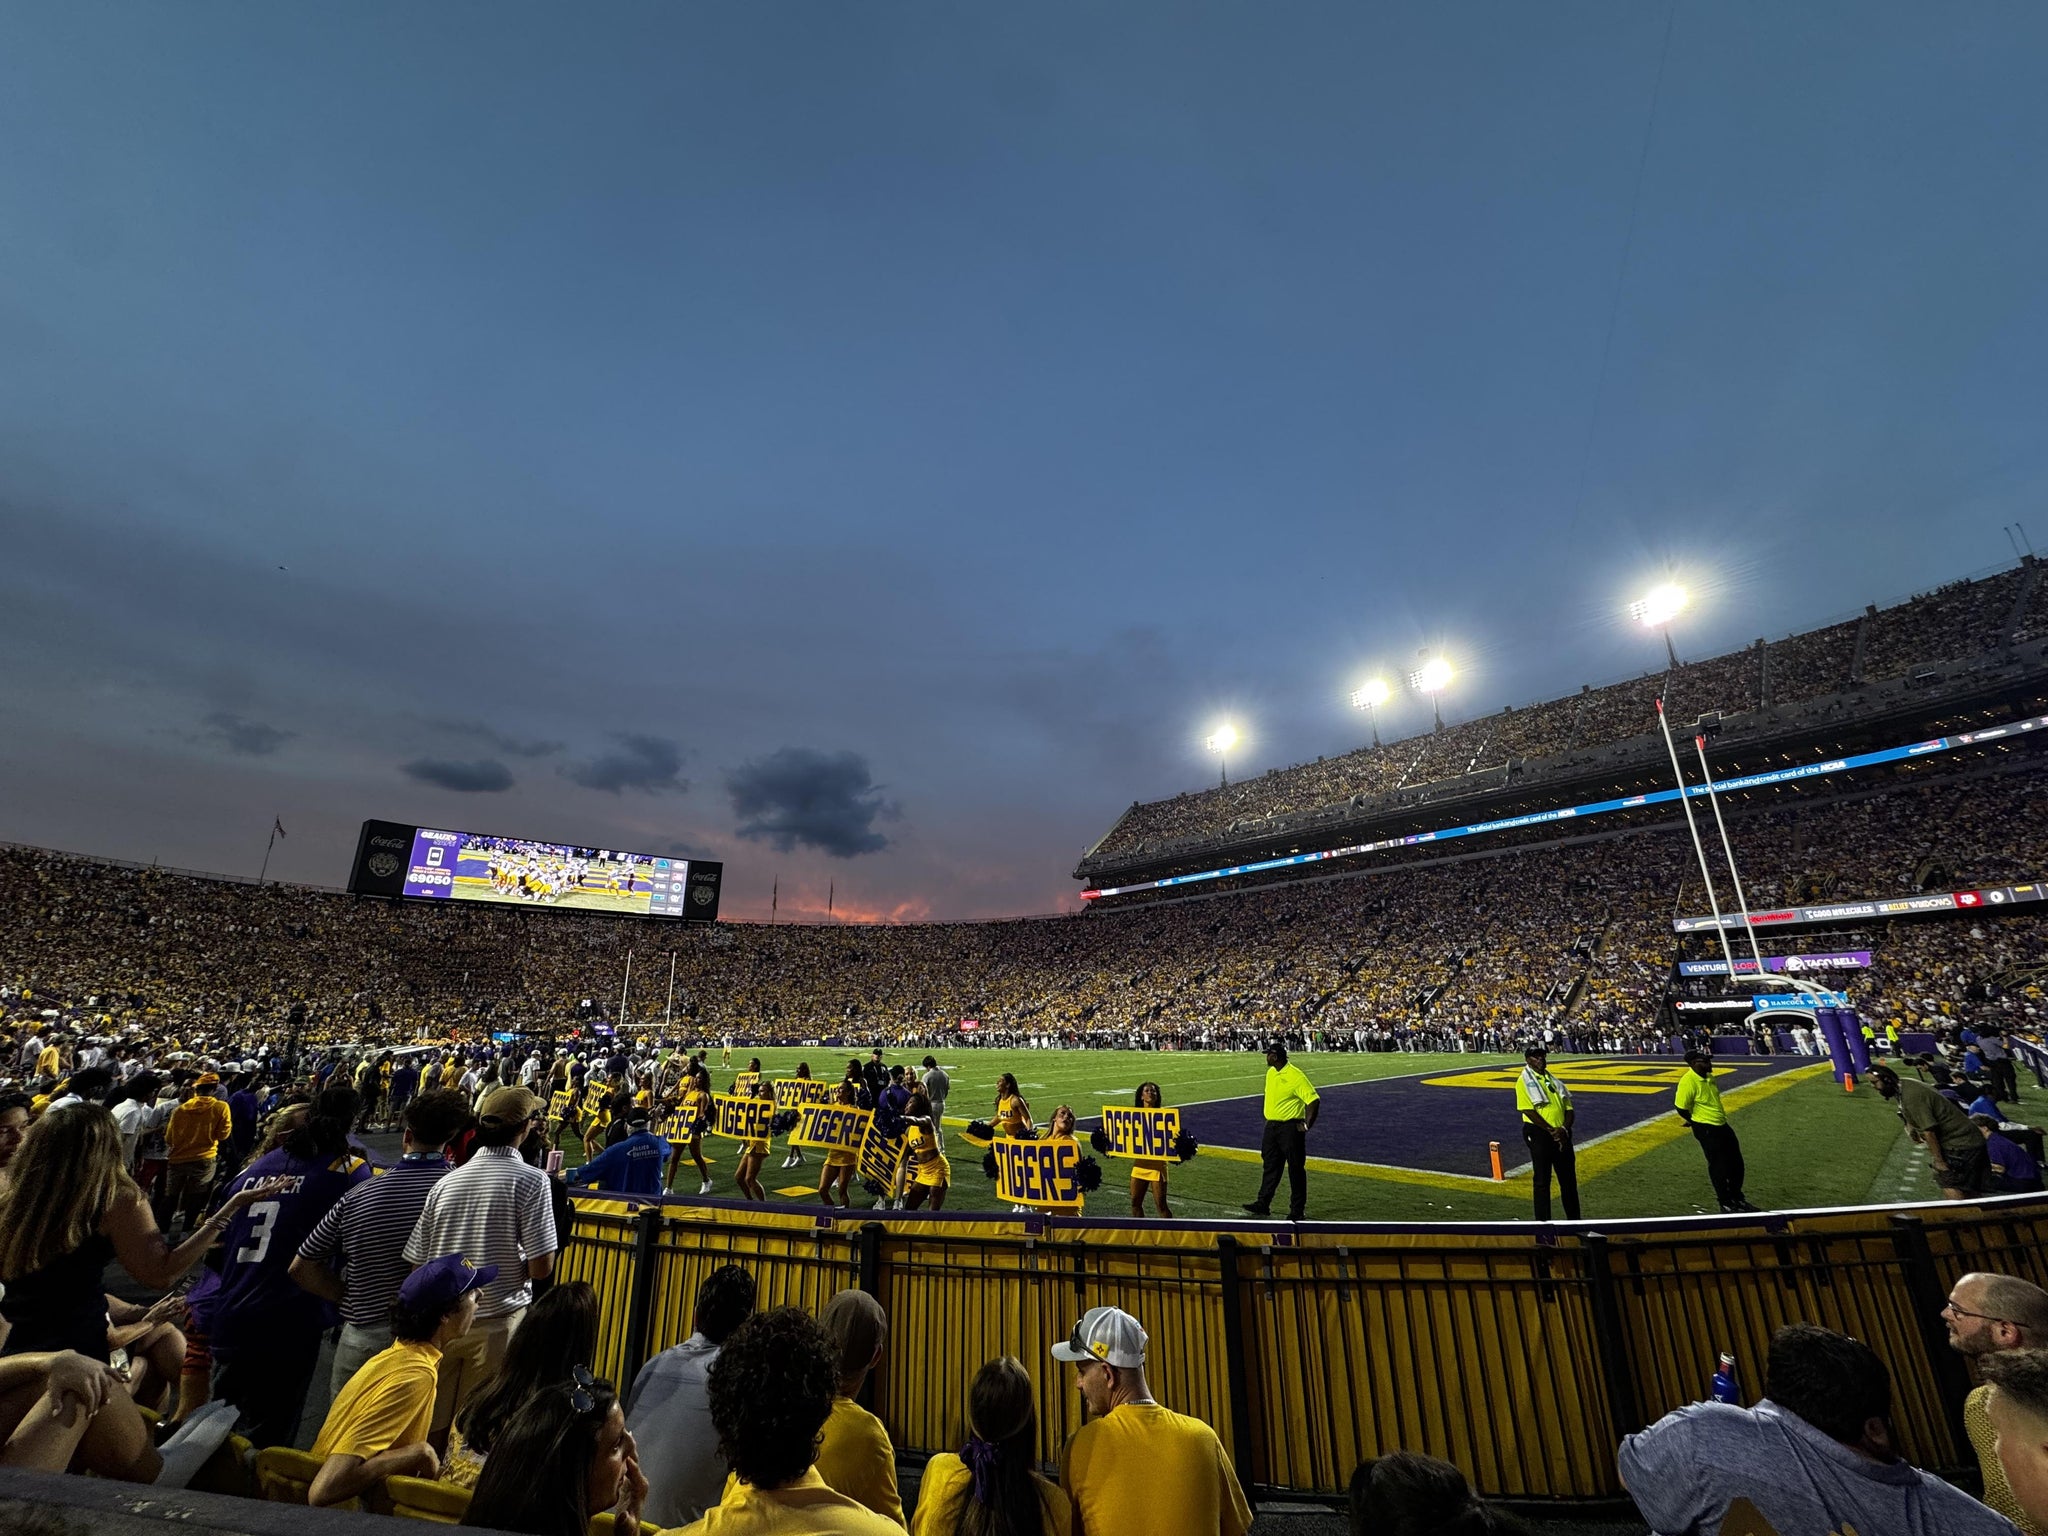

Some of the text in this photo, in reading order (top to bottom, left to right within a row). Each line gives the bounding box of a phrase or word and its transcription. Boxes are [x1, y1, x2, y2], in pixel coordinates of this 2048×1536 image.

[1691, 786, 1705, 794] The
[1705, 782, 1727, 793] oicial
[1780, 770, 1796, 779] card
[1806, 766, 1819, 774] the
[409, 873, 451, 885] 69050
[1814, 905, 1874, 918] GOOD MOLECULES
[1909, 898, 1952, 909] WINDOWS
[1686, 963, 1728, 973] VENTURE
[1804, 957, 1861, 968] TACO BELL
[776, 1081, 823, 1107] DEFENSE
[715, 1098, 771, 1138] TIGERS
[799, 1108, 869, 1149] TIGERS
[1105, 1110, 1178, 1157] DEFENSE
[995, 1142, 1078, 1201] TIGERS
[237, 1201, 280, 1263] 3
